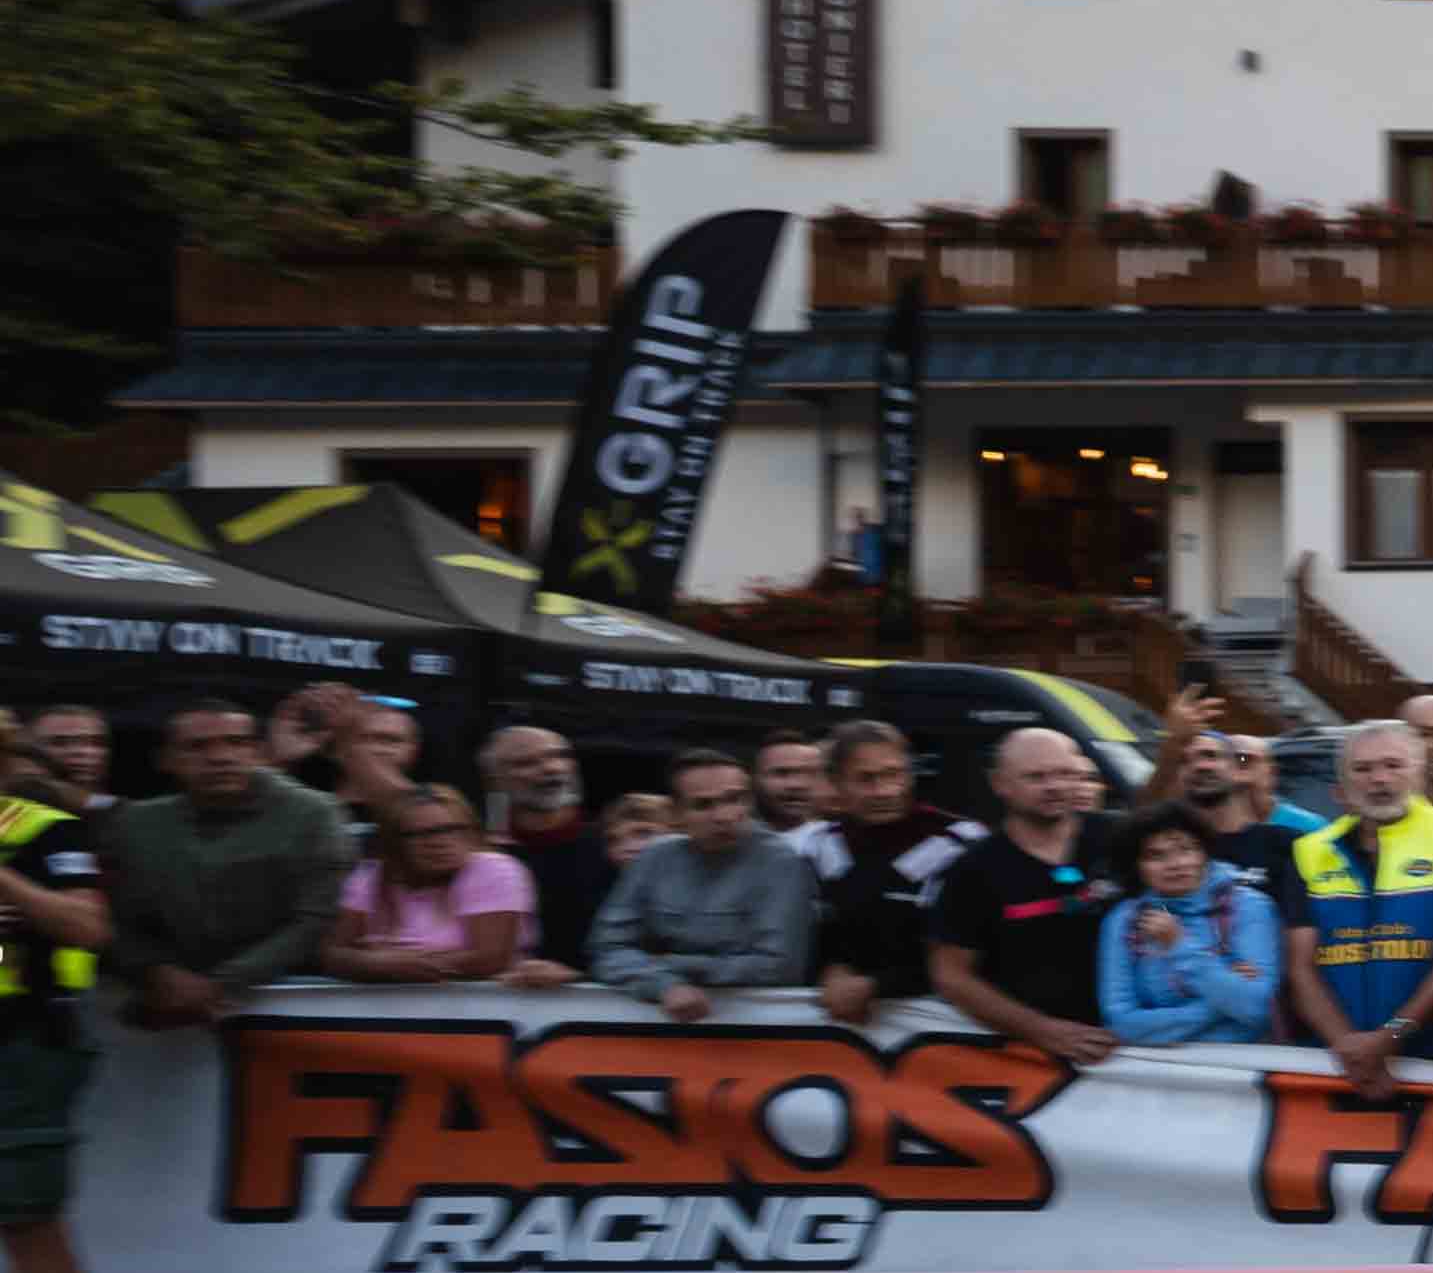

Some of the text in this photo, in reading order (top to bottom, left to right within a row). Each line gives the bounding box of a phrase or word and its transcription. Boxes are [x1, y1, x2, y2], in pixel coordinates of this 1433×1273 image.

[41, 615, 163, 653] STAY
[169, 622, 241, 654] ON
[244, 627, 384, 670] TRACK
[713, 672, 813, 705] TRACK
[378, 1186, 884, 1272] RACING
